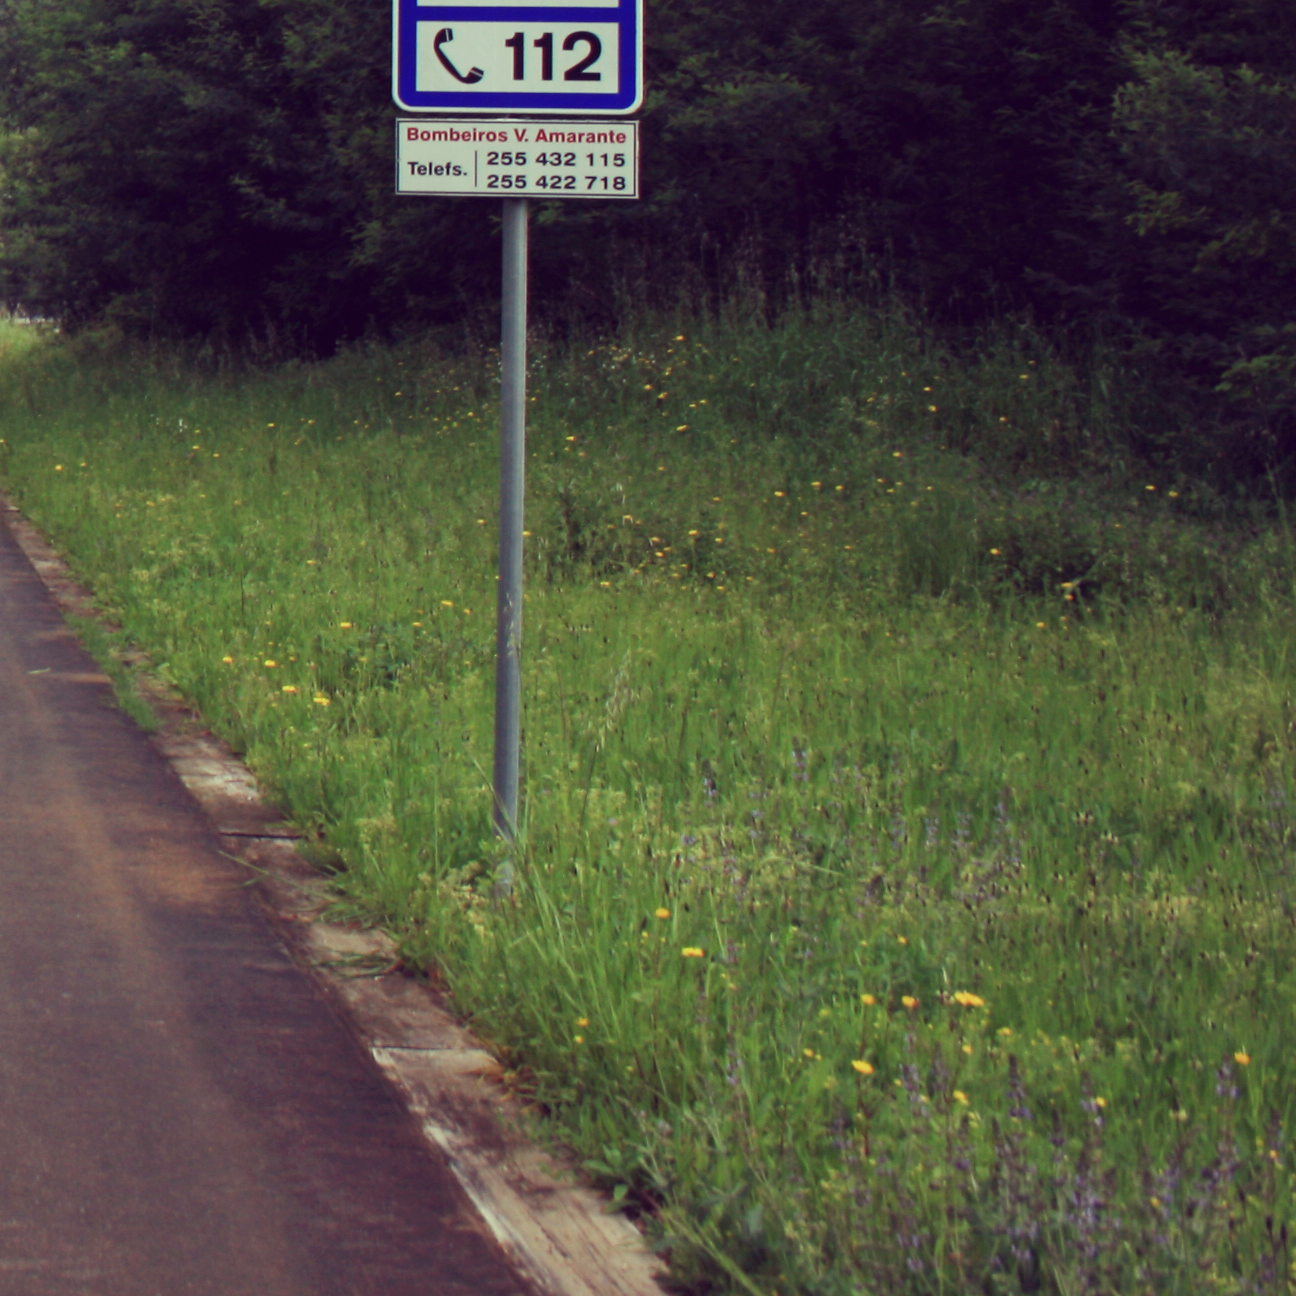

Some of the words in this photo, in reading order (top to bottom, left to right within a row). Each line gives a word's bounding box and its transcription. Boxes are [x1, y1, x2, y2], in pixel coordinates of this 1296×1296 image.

[504, 30, 602, 82] 112
[406, 127, 508, 142] Bombeiros
[514, 128, 529, 143] V.
[535, 129, 627, 144] Amarante
[486, 151, 527, 166] 255
[535, 152, 576, 167] 432
[585, 153, 626, 167] 115
[407, 161, 468, 176] Telefs.
[486, 174, 527, 189] 255
[535, 175, 576, 190] 422
[584, 176, 626, 190] 718
